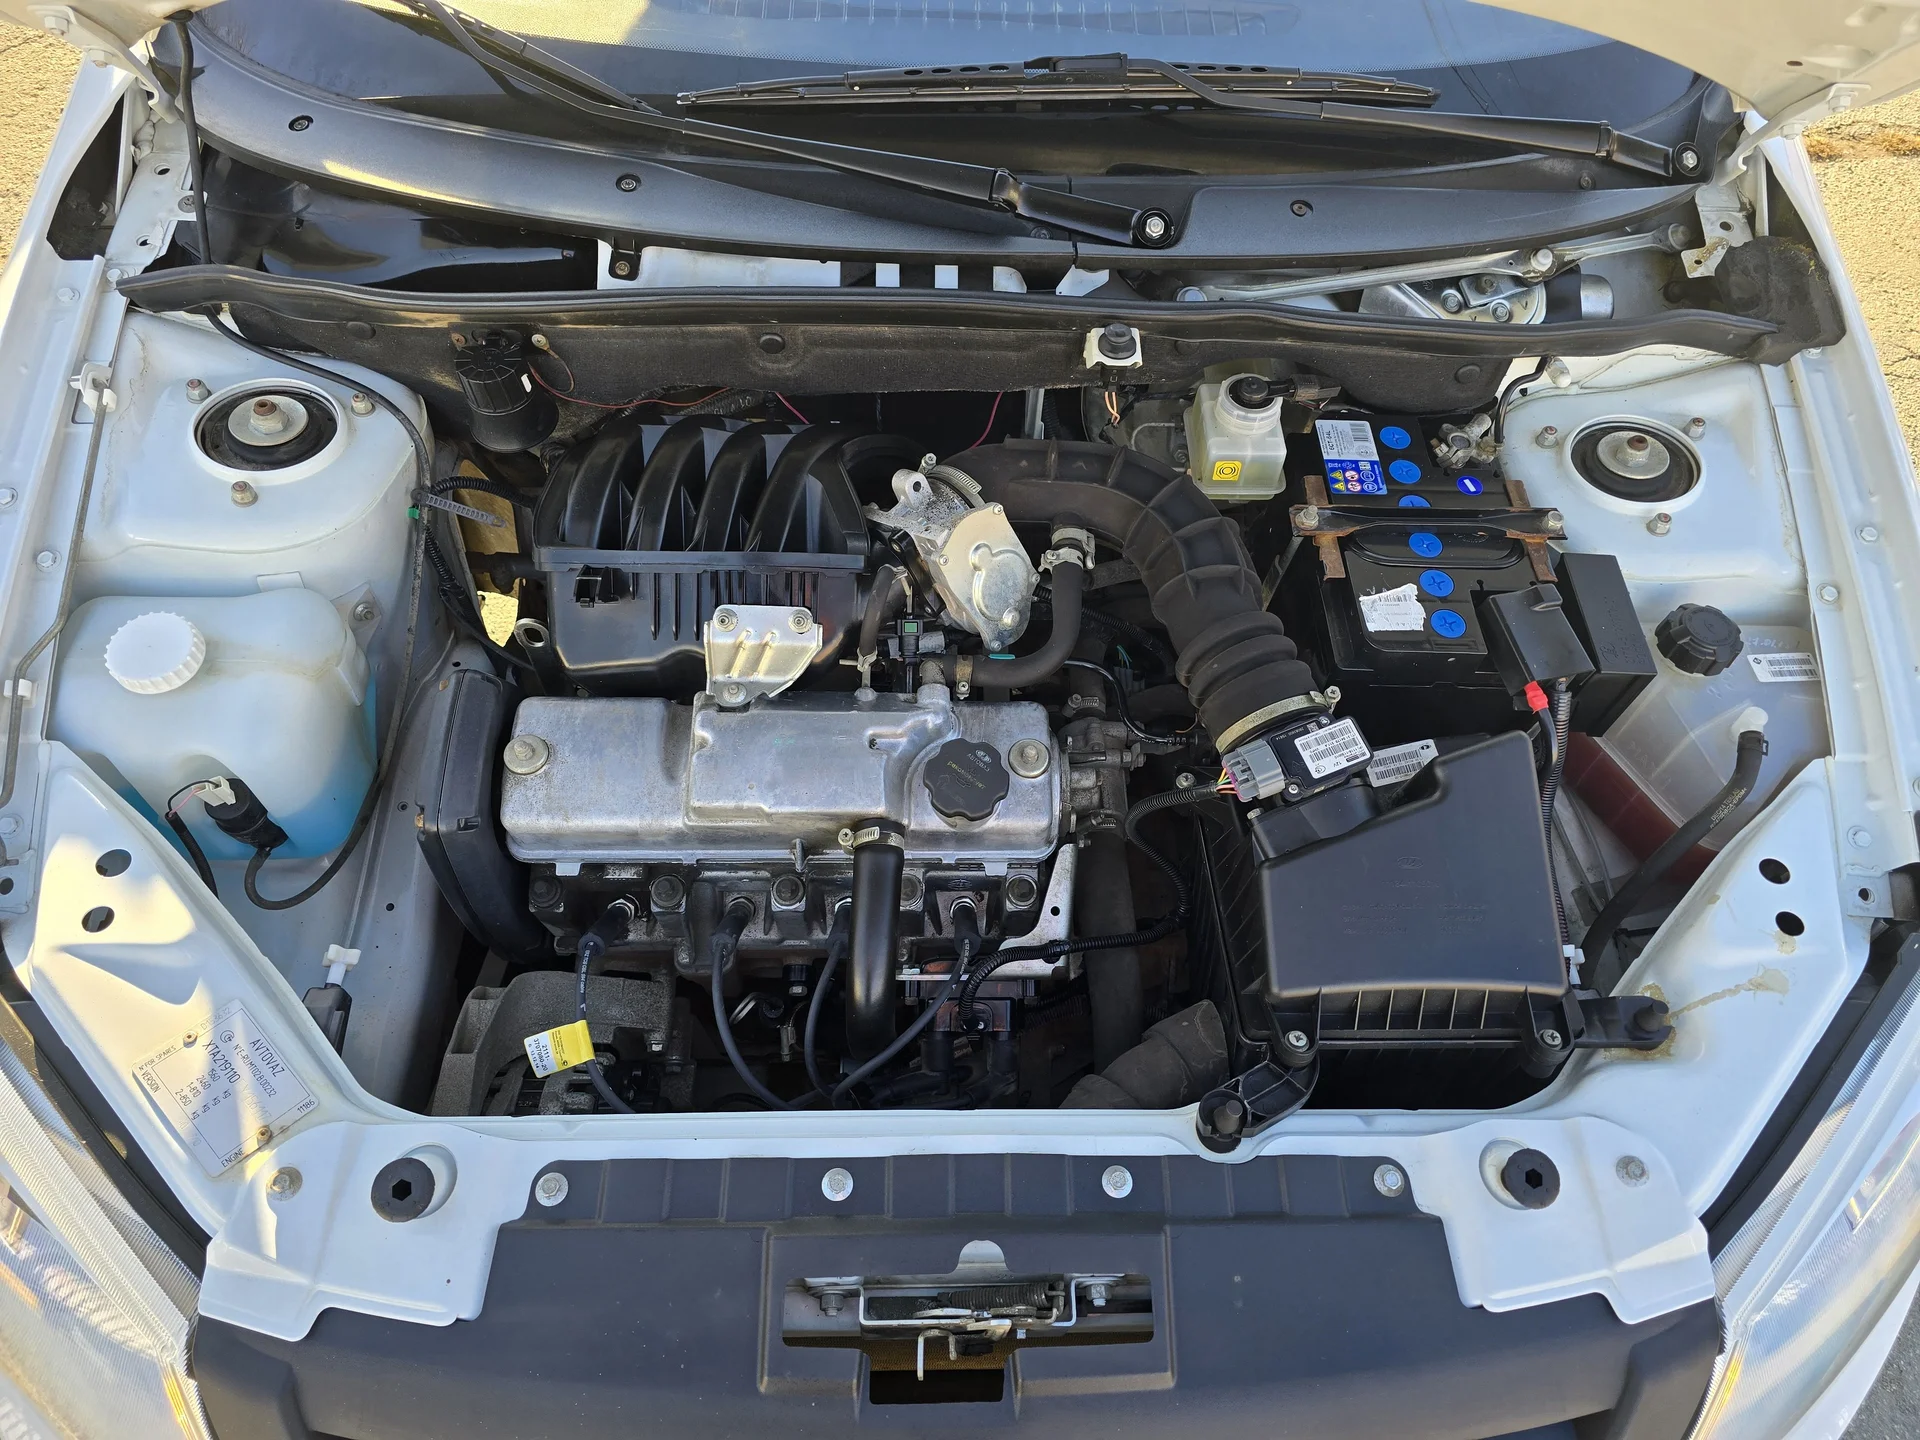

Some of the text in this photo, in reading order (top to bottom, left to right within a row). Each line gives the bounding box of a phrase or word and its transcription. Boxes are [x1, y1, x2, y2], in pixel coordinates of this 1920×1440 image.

[145, 1058, 155, 1067] FOR
[156, 1045, 177, 1061] SPARES
[202, 1040, 241, 1084] XTA219110
[250, 1038, 285, 1077] AVTOVAZ
[140, 1069, 160, 1093] VERSION
[196, 1075, 221, 1106] 2460 kg
[209, 1068, 231, 1099] 1560 kg
[174, 1088, 192, 1107] 2-850
[191, 1111, 199, 1120] kg
[188, 1082, 210, 1113] 1-810 kg
[297, 1099, 315, 1114] 11186
[221, 1148, 244, 1168] ENGINE
